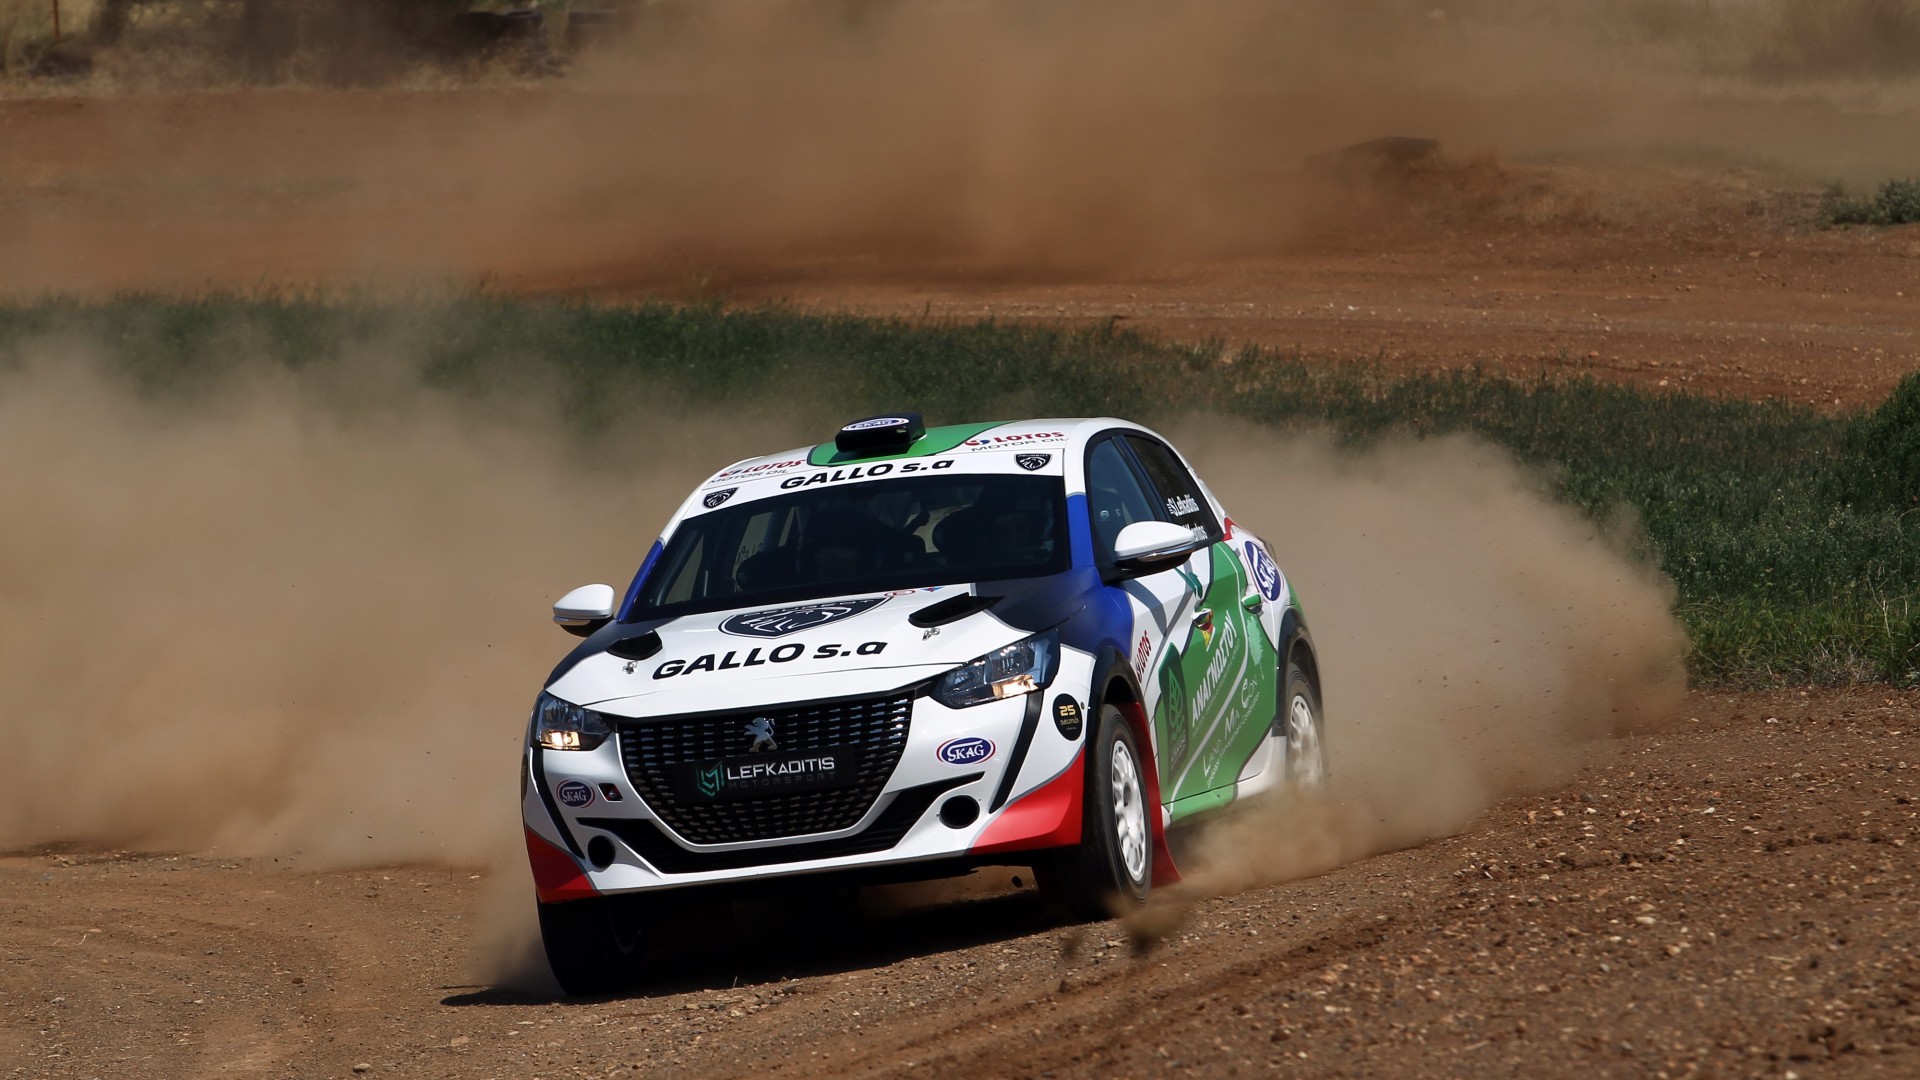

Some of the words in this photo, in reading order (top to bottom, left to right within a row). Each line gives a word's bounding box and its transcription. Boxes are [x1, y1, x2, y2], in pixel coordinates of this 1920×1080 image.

[972, 439, 1036, 452] MOTOR
[992, 431, 1065, 443] LOTOS
[708, 471, 763, 484] MOTOR
[766, 468, 789, 476] OIL
[743, 459, 807, 474] LOTOS
[779, 462, 894, 490] GALLO
[899, 459, 955, 474] s.a
[1251, 543, 1276, 599] SKAG
[652, 642, 806, 681] GALLO
[812, 641, 889, 660] s.a
[1191, 609, 1238, 729] ΑΝΑΓΝΩΣΤΟΥ
[1058, 704, 1077, 717] 25
[947, 740, 985, 762] SKAG
[727, 756, 836, 780] LEFKADITIS
[728, 771, 837, 790] MOTORSPORT
[562, 786, 588, 803] SKAG
